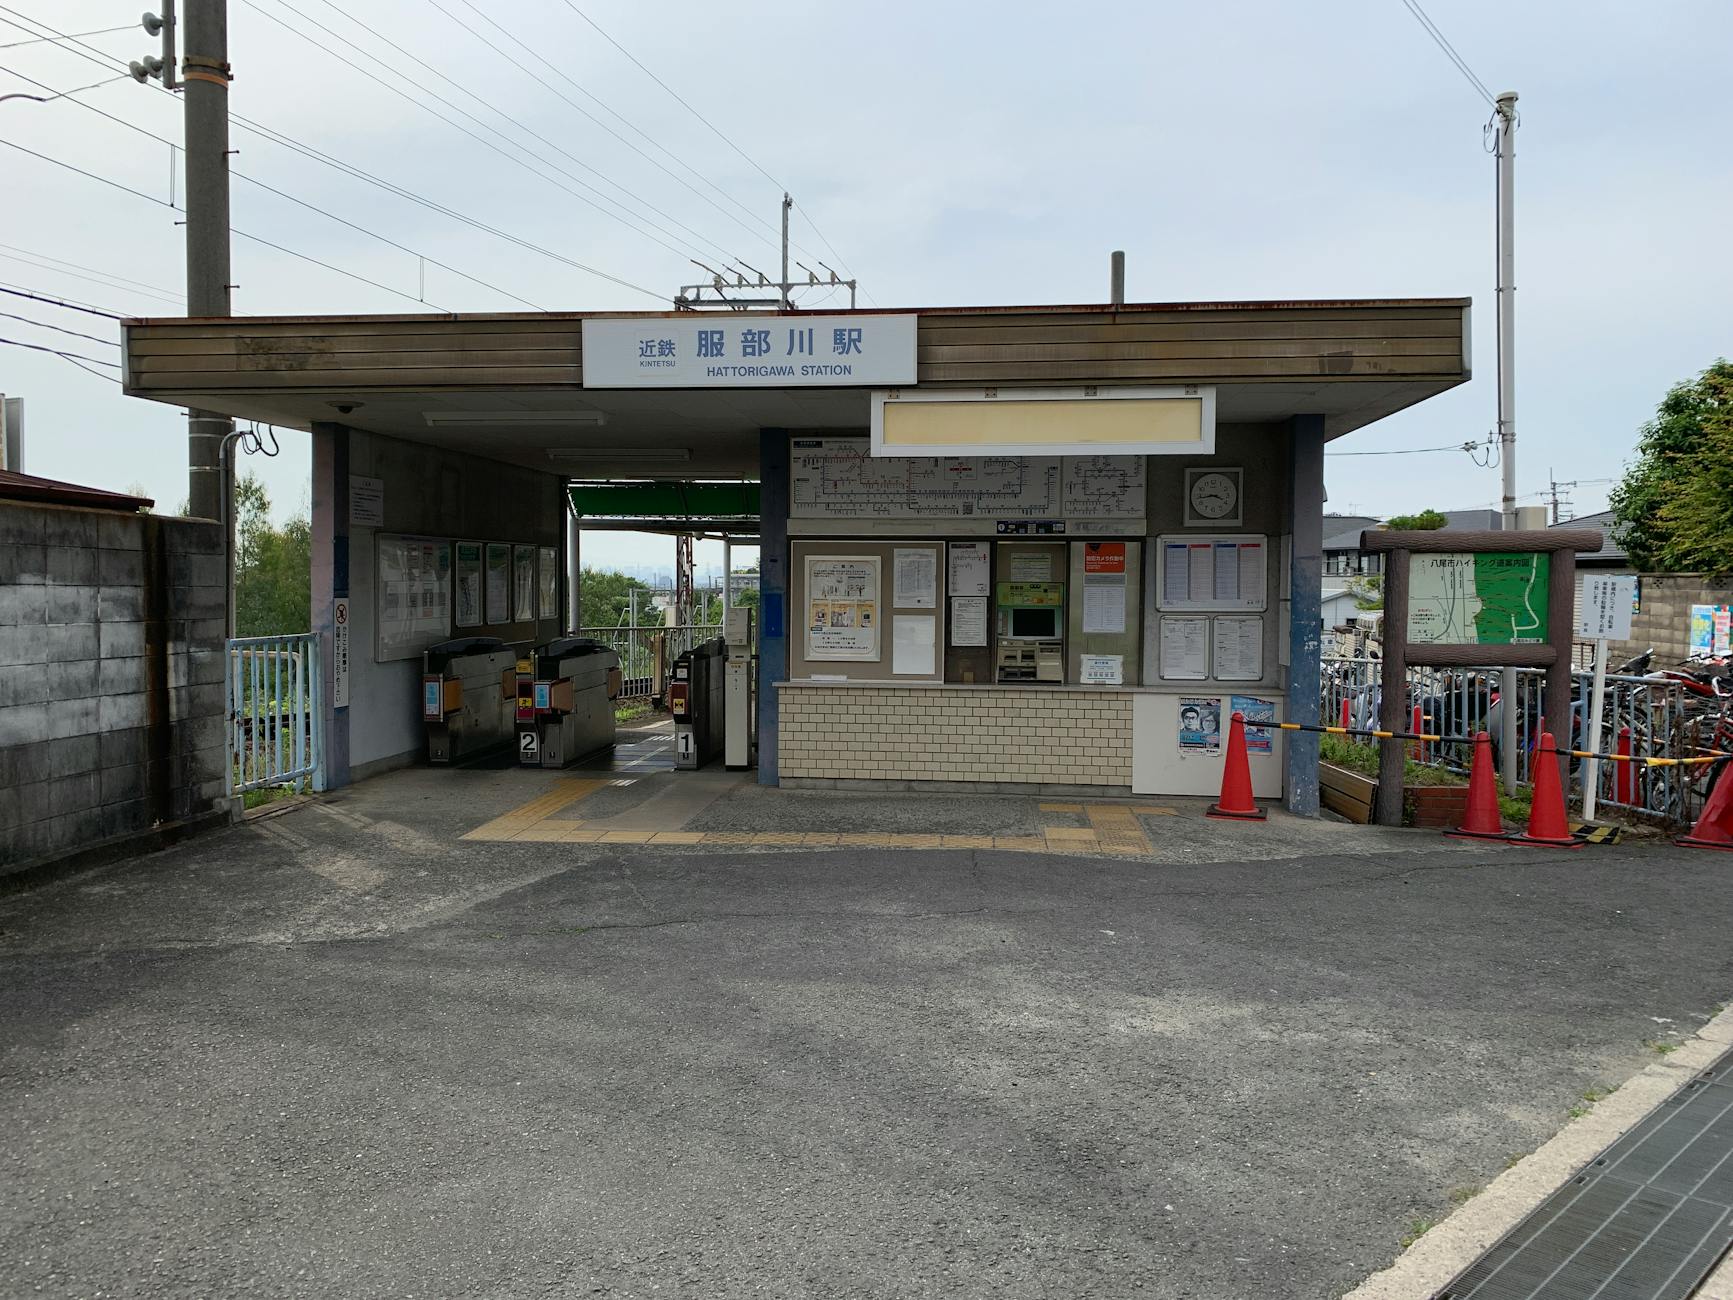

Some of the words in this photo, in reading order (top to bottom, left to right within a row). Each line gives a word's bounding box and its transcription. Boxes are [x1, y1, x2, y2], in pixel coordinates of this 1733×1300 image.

[639, 339, 676, 357] 近鉄
[697, 328, 862, 357] 服部川駅
[707, 366, 795, 377] HATTORIGAWA
[801, 365, 851, 376] STATION
[522, 733, 536, 751] 2
[681, 733, 689, 751] 1
